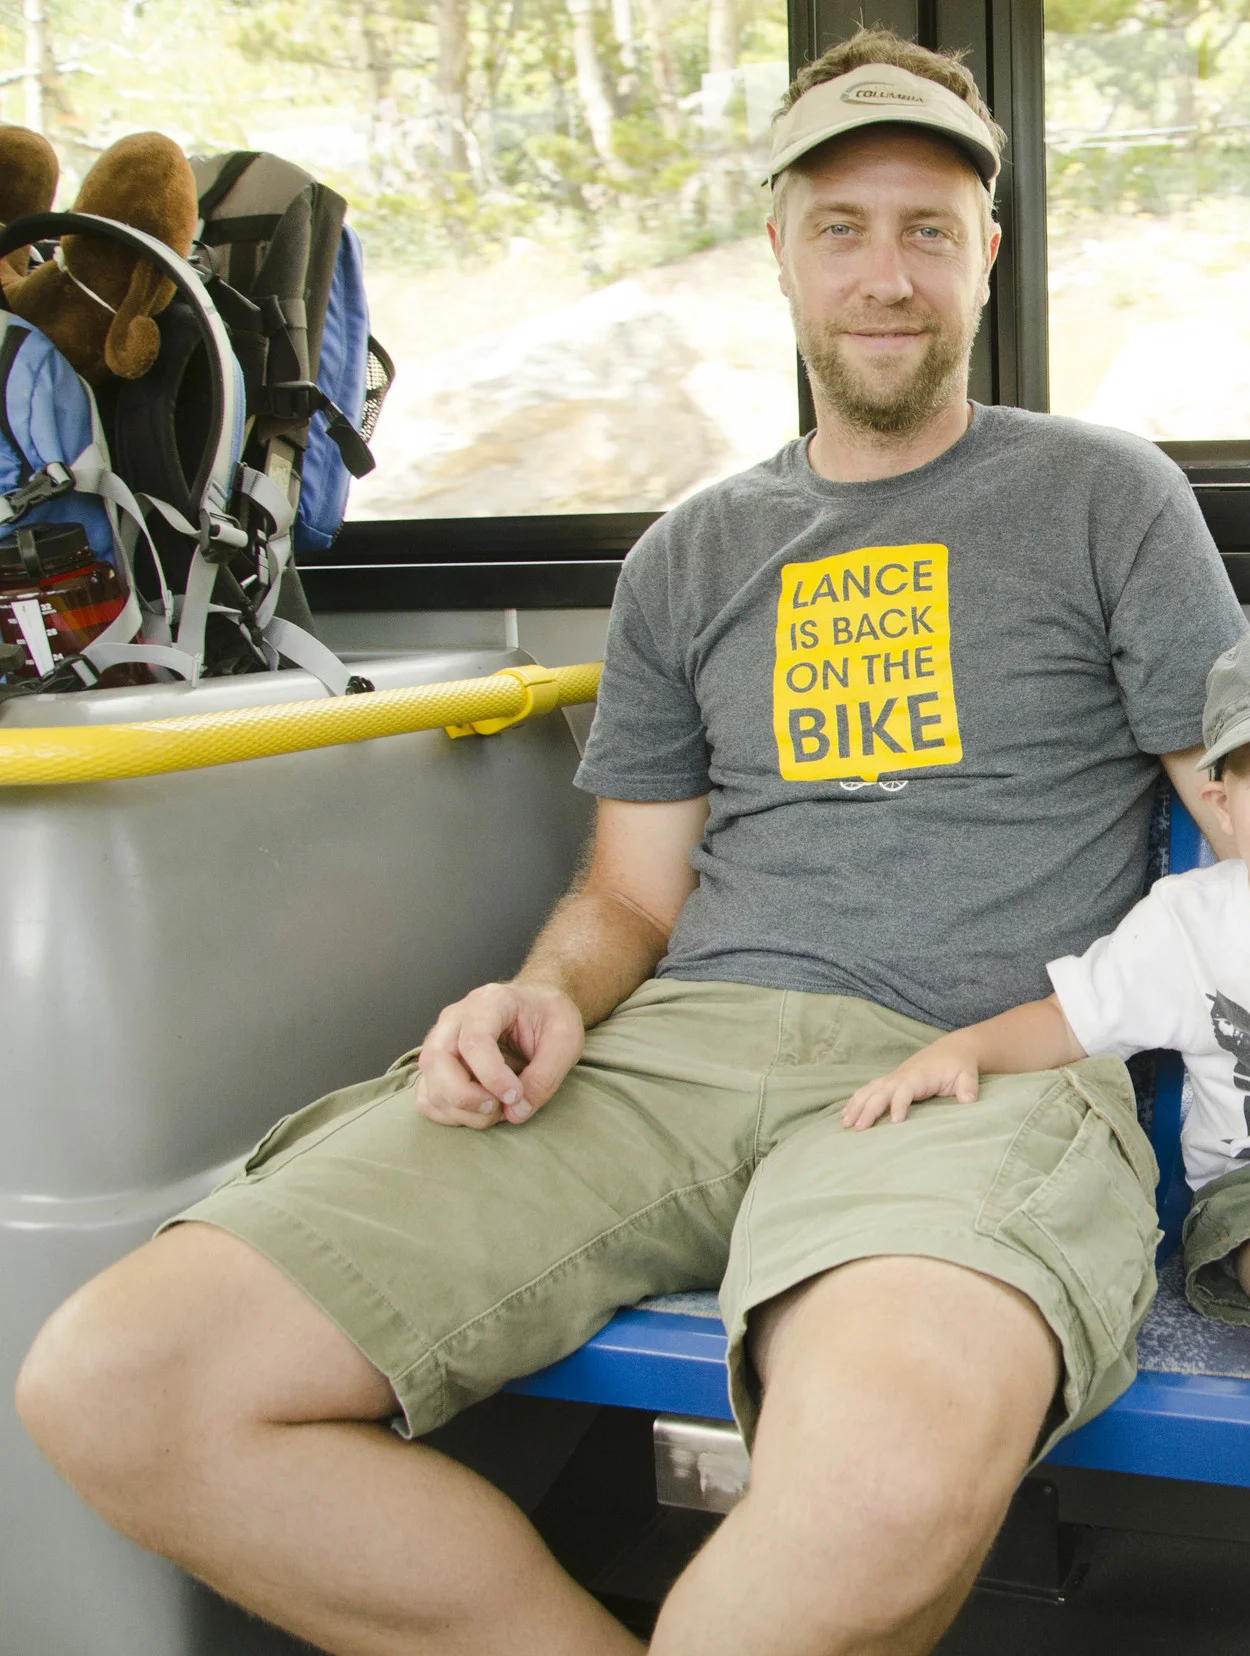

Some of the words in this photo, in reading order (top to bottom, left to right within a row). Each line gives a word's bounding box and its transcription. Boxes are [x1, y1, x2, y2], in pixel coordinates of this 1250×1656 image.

[792, 560, 933, 609] LANCE
[790, 619, 819, 651] IS
[833, 605, 935, 646] BACK
[786, 657, 849, 693] ON
[861, 645, 935, 685] THE
[788, 691, 946, 763] BIKE
